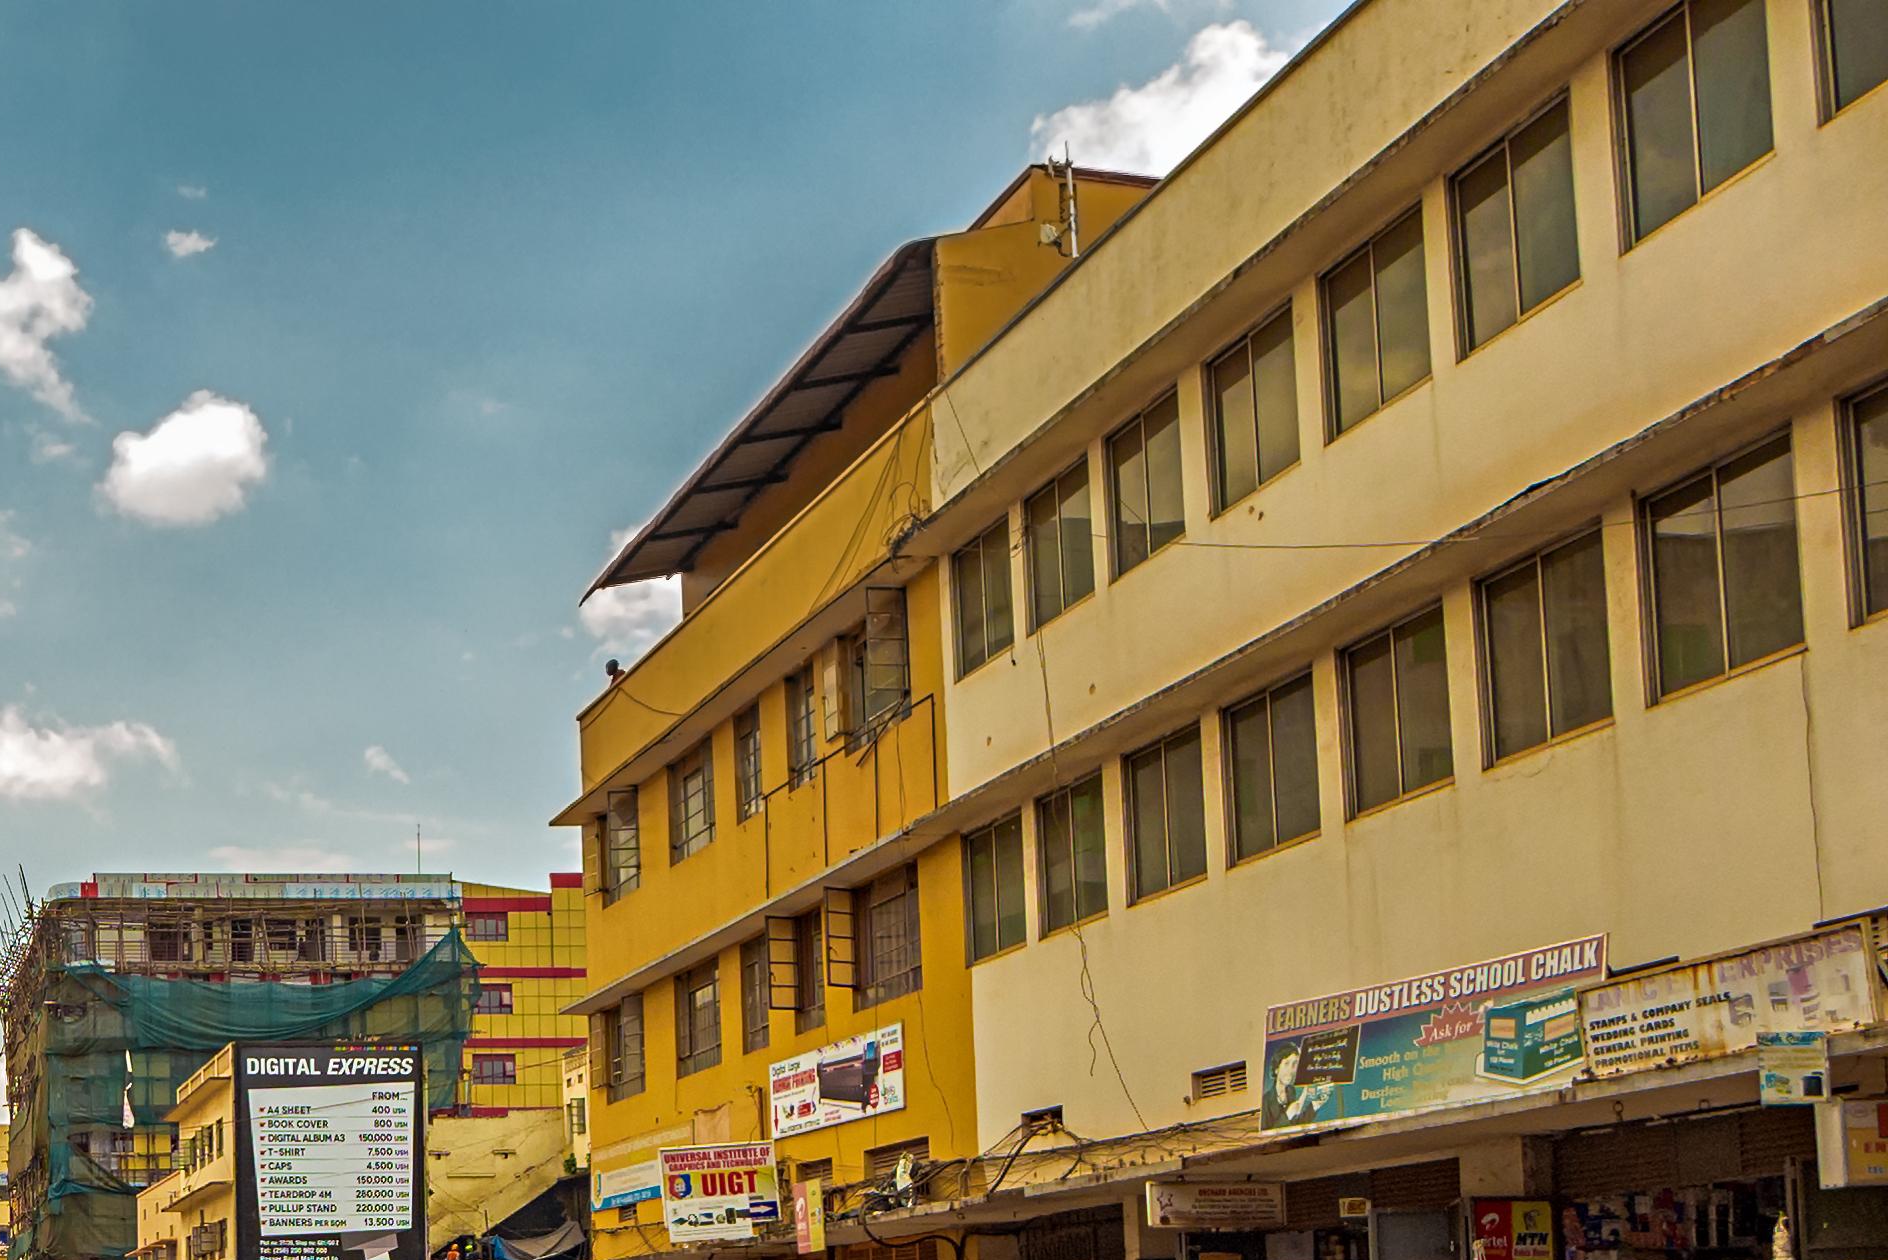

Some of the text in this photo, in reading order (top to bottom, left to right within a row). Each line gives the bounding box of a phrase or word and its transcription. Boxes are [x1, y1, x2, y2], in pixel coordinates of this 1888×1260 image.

[1266, 939, 1601, 1035] LEARNERS DUSTLESS SCHOOL CHALK
[1588, 1014, 1628, 1032] STAMPS
[1641, 1000, 1692, 1021] COMPANY
[1695, 991, 1732, 1008] SEALS
[1428, 1020, 1474, 1043] Ask for
[1589, 1017, 1676, 1044] WEDDING CARDS
[1592, 1028, 1690, 1056] GENERAL PRINTING
[1359, 1053, 1401, 1070] Smooth
[1594, 1040, 1701, 1070] PROMOTIONAL ITEMS
[246, 1056, 415, 1076] DIGITAL EXPRESS
[267, 1105, 392, 1115] A4 SHEET 400
[267, 1119, 393, 1129] BOOK COVER 800
[267, 1133, 346, 1143] DIGITAL ALBUM A3
[268, 1147, 307, 1157] T-SHIRT
[663, 1147, 771, 1165] UNIVERSAL INSTITUTE OF
[268, 1161, 293, 1171] CAPS
[668, 1157, 768, 1173] GRAPHICS AND TECHNOLOGY
[268, 1175, 308, 1185] AWARDS
[700, 1170, 758, 1197] UIGT
[268, 1189, 332, 1199] TEARDROP 4M
[268, 1203, 338, 1213] PULLUP STAND
[269, 1217, 313, 1228] BANNERS
[1514, 1231, 1550, 1247] MTN
